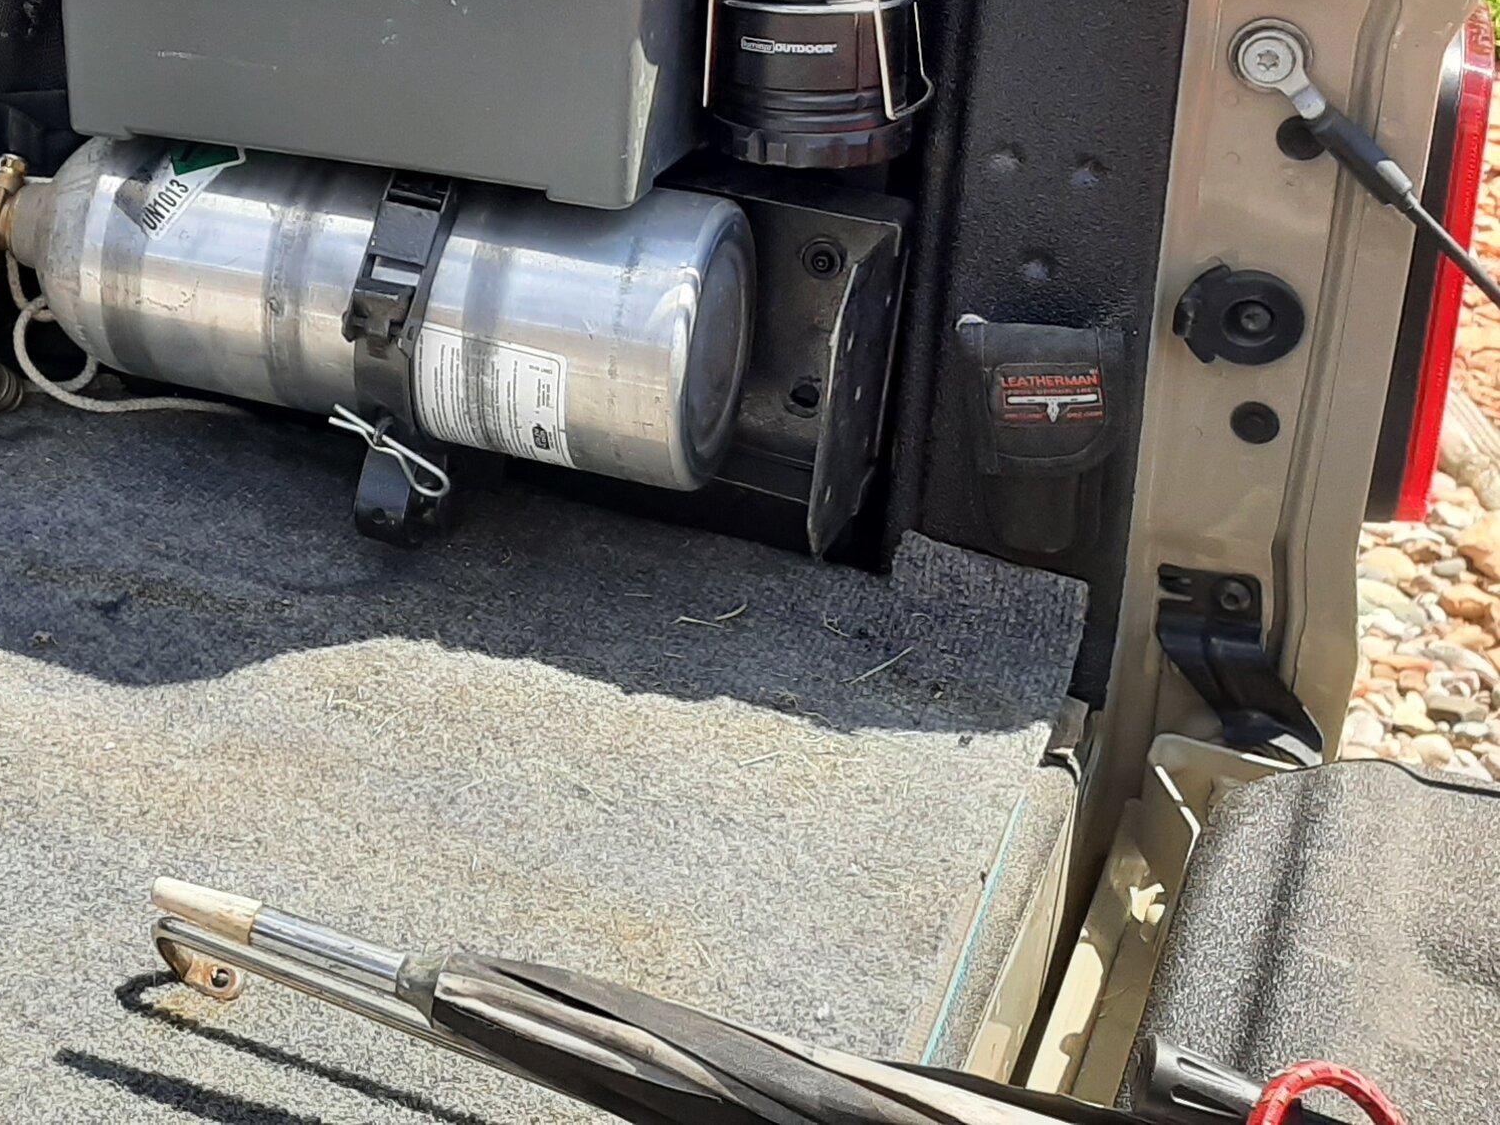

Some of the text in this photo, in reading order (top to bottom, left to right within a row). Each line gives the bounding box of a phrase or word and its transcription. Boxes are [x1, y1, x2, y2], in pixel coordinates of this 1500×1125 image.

[774, 42, 834, 53] OUTDOOR
[142, 178, 189, 231] UN1013
[1001, 375, 1098, 388] LEATHERMAN
